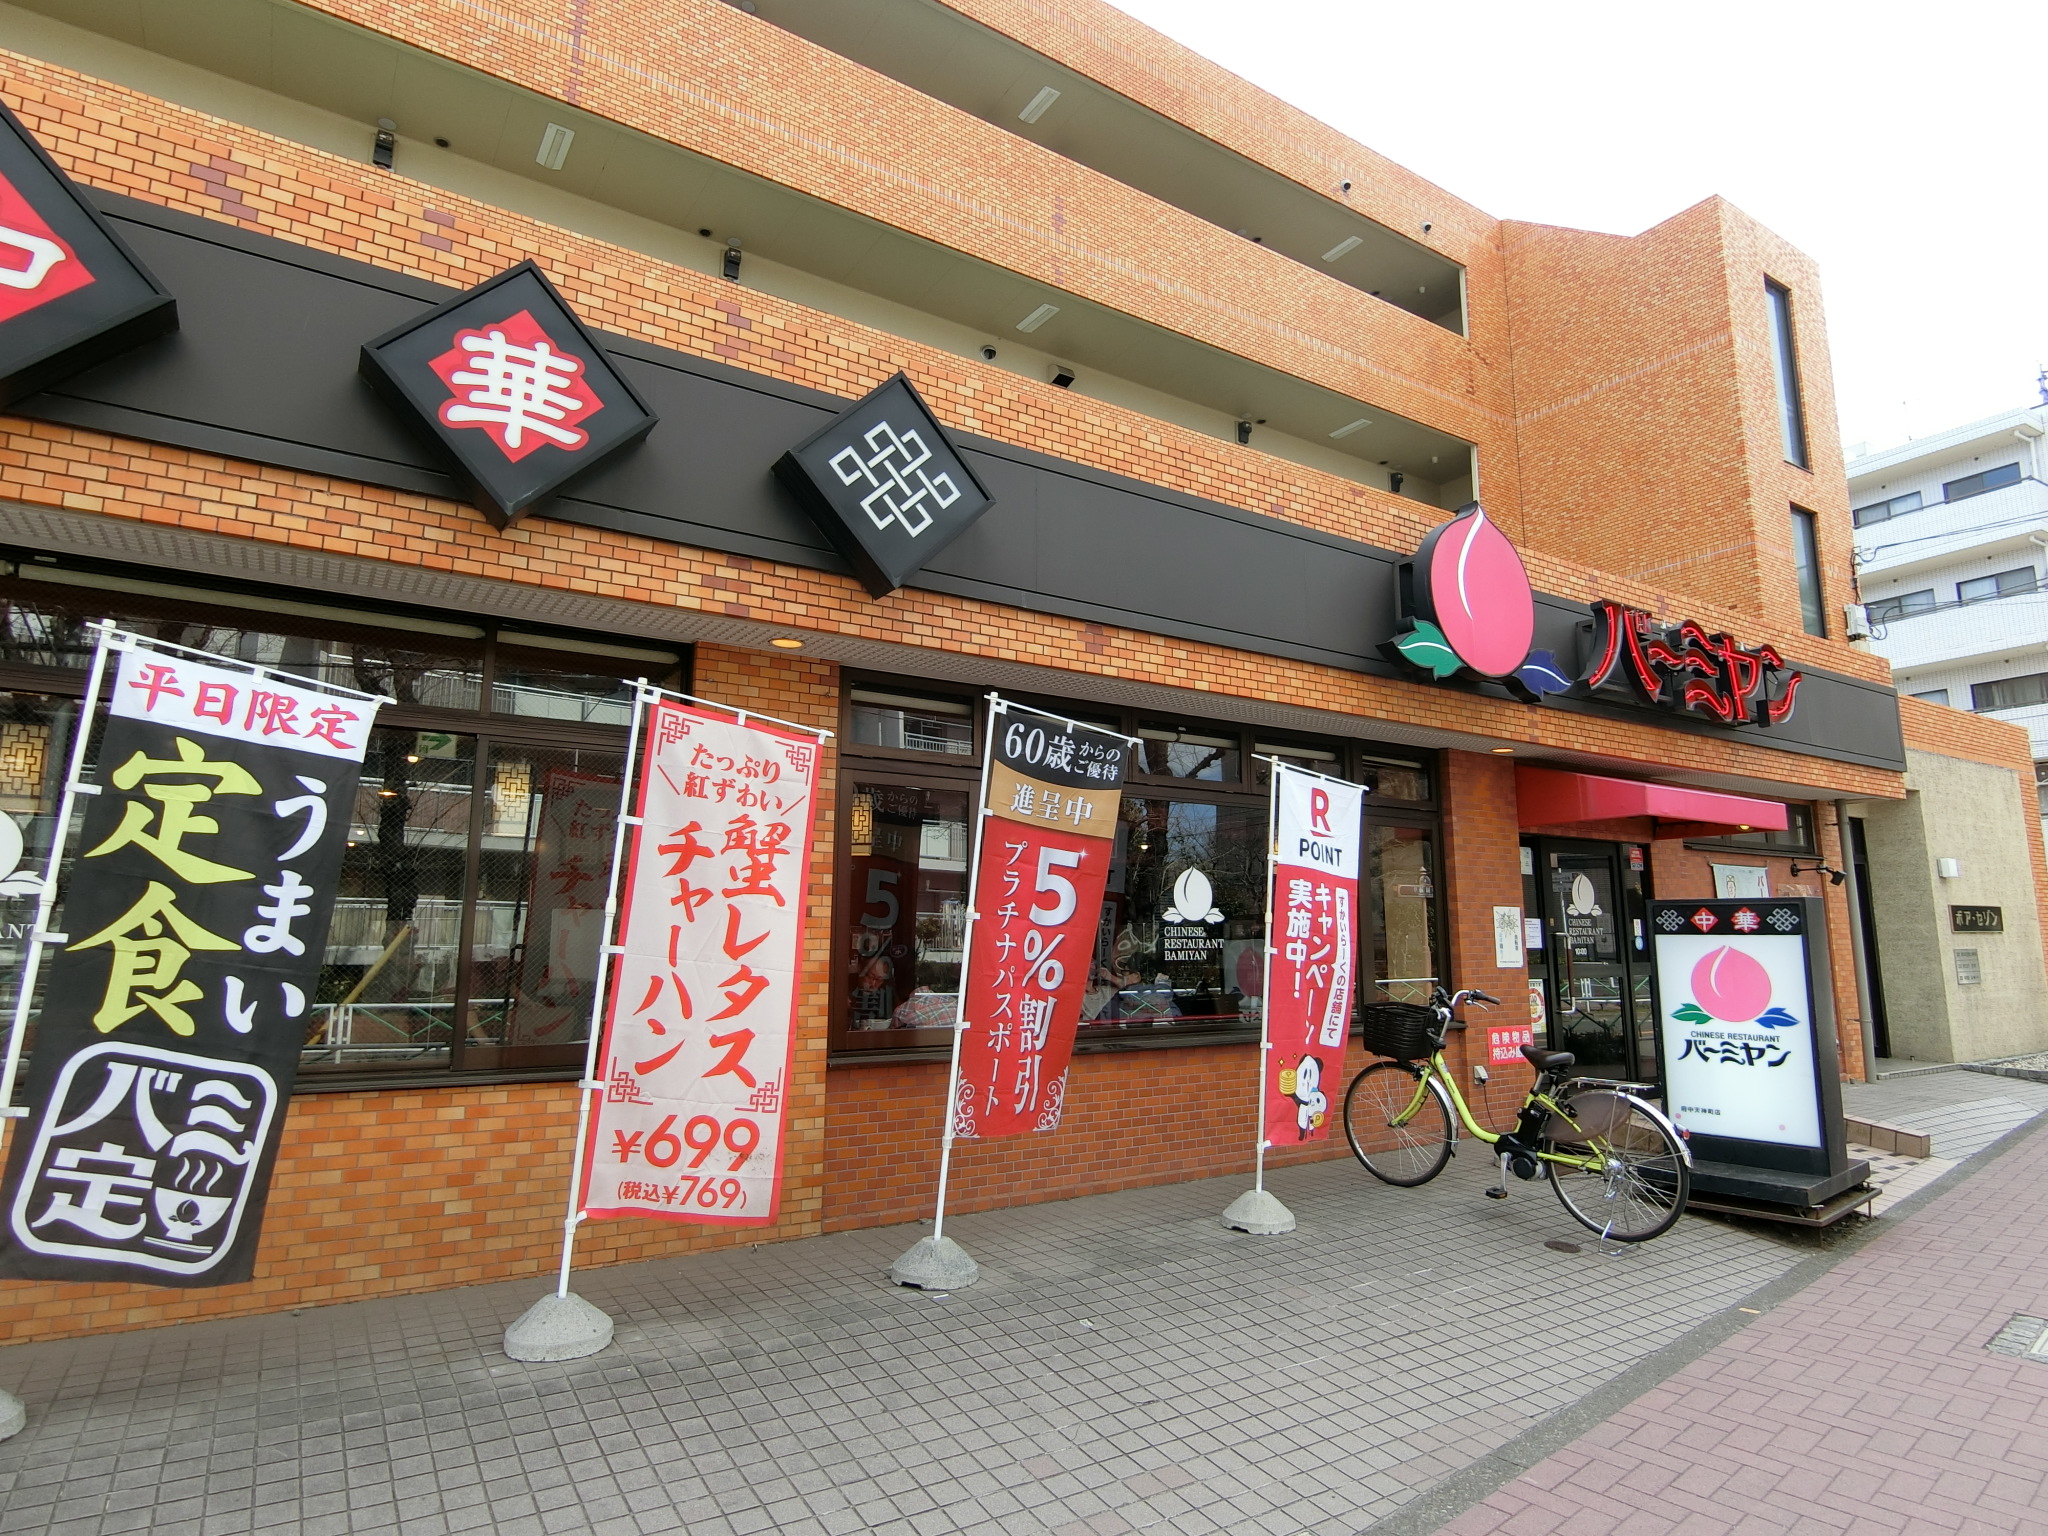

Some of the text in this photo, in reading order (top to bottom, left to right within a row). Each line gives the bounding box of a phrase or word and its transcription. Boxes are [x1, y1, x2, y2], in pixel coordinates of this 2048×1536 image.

[446, 330, 583, 449] 華
[1583, 601, 1802, 727] バーミヤン
[127, 663, 361, 750] 平日限定
[690, 743, 781, 784] たっぷり
[1004, 722, 1077, 773] 60歳
[1073, 760, 1119, 781] ご優待
[1079, 742, 1121, 762] からの
[683, 772, 783, 811] 紅ずわい
[1010, 782, 1094, 826] 進呈中
[1311, 787, 1332, 833] R
[1300, 838, 1343, 867] POINT
[64, 736, 263, 1037] 定食
[225, 775, 329, 1034] うまい
[1164, 926, 1204, 937] CHINESE
[1164, 938, 1225, 949] RESTAURANT
[1694, 910, 1759, 931] 中 華
[632, 820, 716, 1076] チャーハン
[700, 813, 792, 1089] 蟹レタス
[1164, 950, 1207, 960] BAMIYAN
[1305, 882, 1333, 1045] キャンペーン
[1326, 896, 1348, 1040] すかいらーくの店舗にて
[985, 840, 1029, 1116] プラチナパスポート
[1014, 846, 1081, 1115] 5%割引
[1677, 1039, 1791, 1067] バーミヤン
[1690, 1030, 1780, 1043] CHINESE RESTAURANT
[612, 1114, 761, 1172] ¥699
